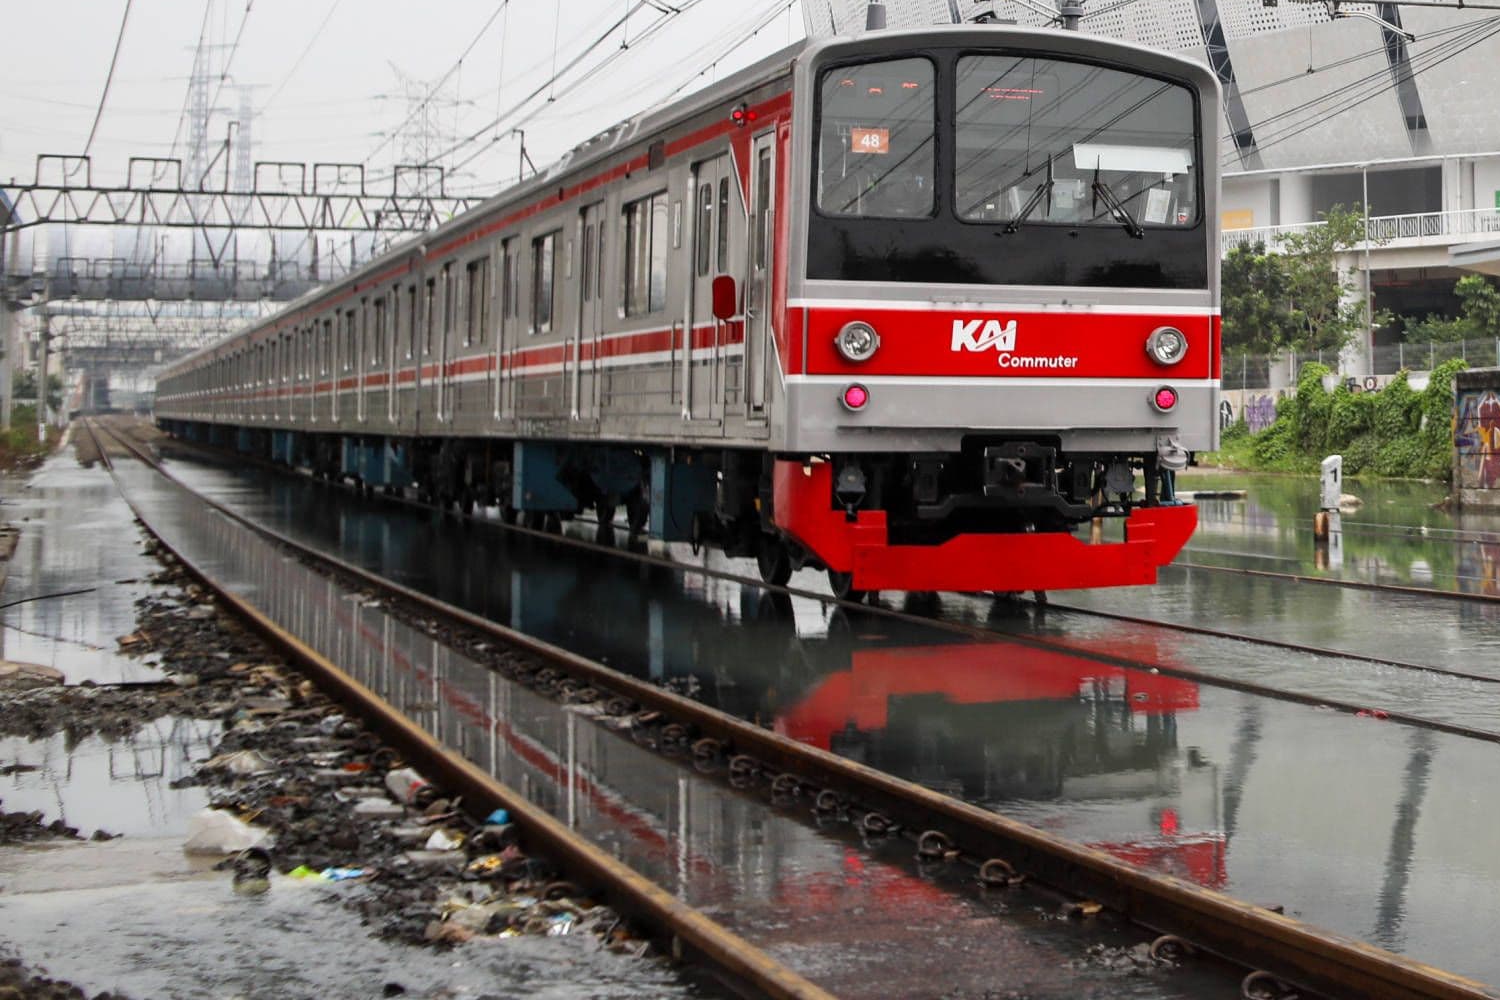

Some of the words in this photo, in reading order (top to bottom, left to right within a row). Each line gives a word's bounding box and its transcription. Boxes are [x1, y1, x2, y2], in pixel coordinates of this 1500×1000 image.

[861, 134, 880, 148] 48
[951, 319, 1017, 352] KAI
[998, 353, 1078, 368] Commuter
[1330, 467, 1338, 482] 1
